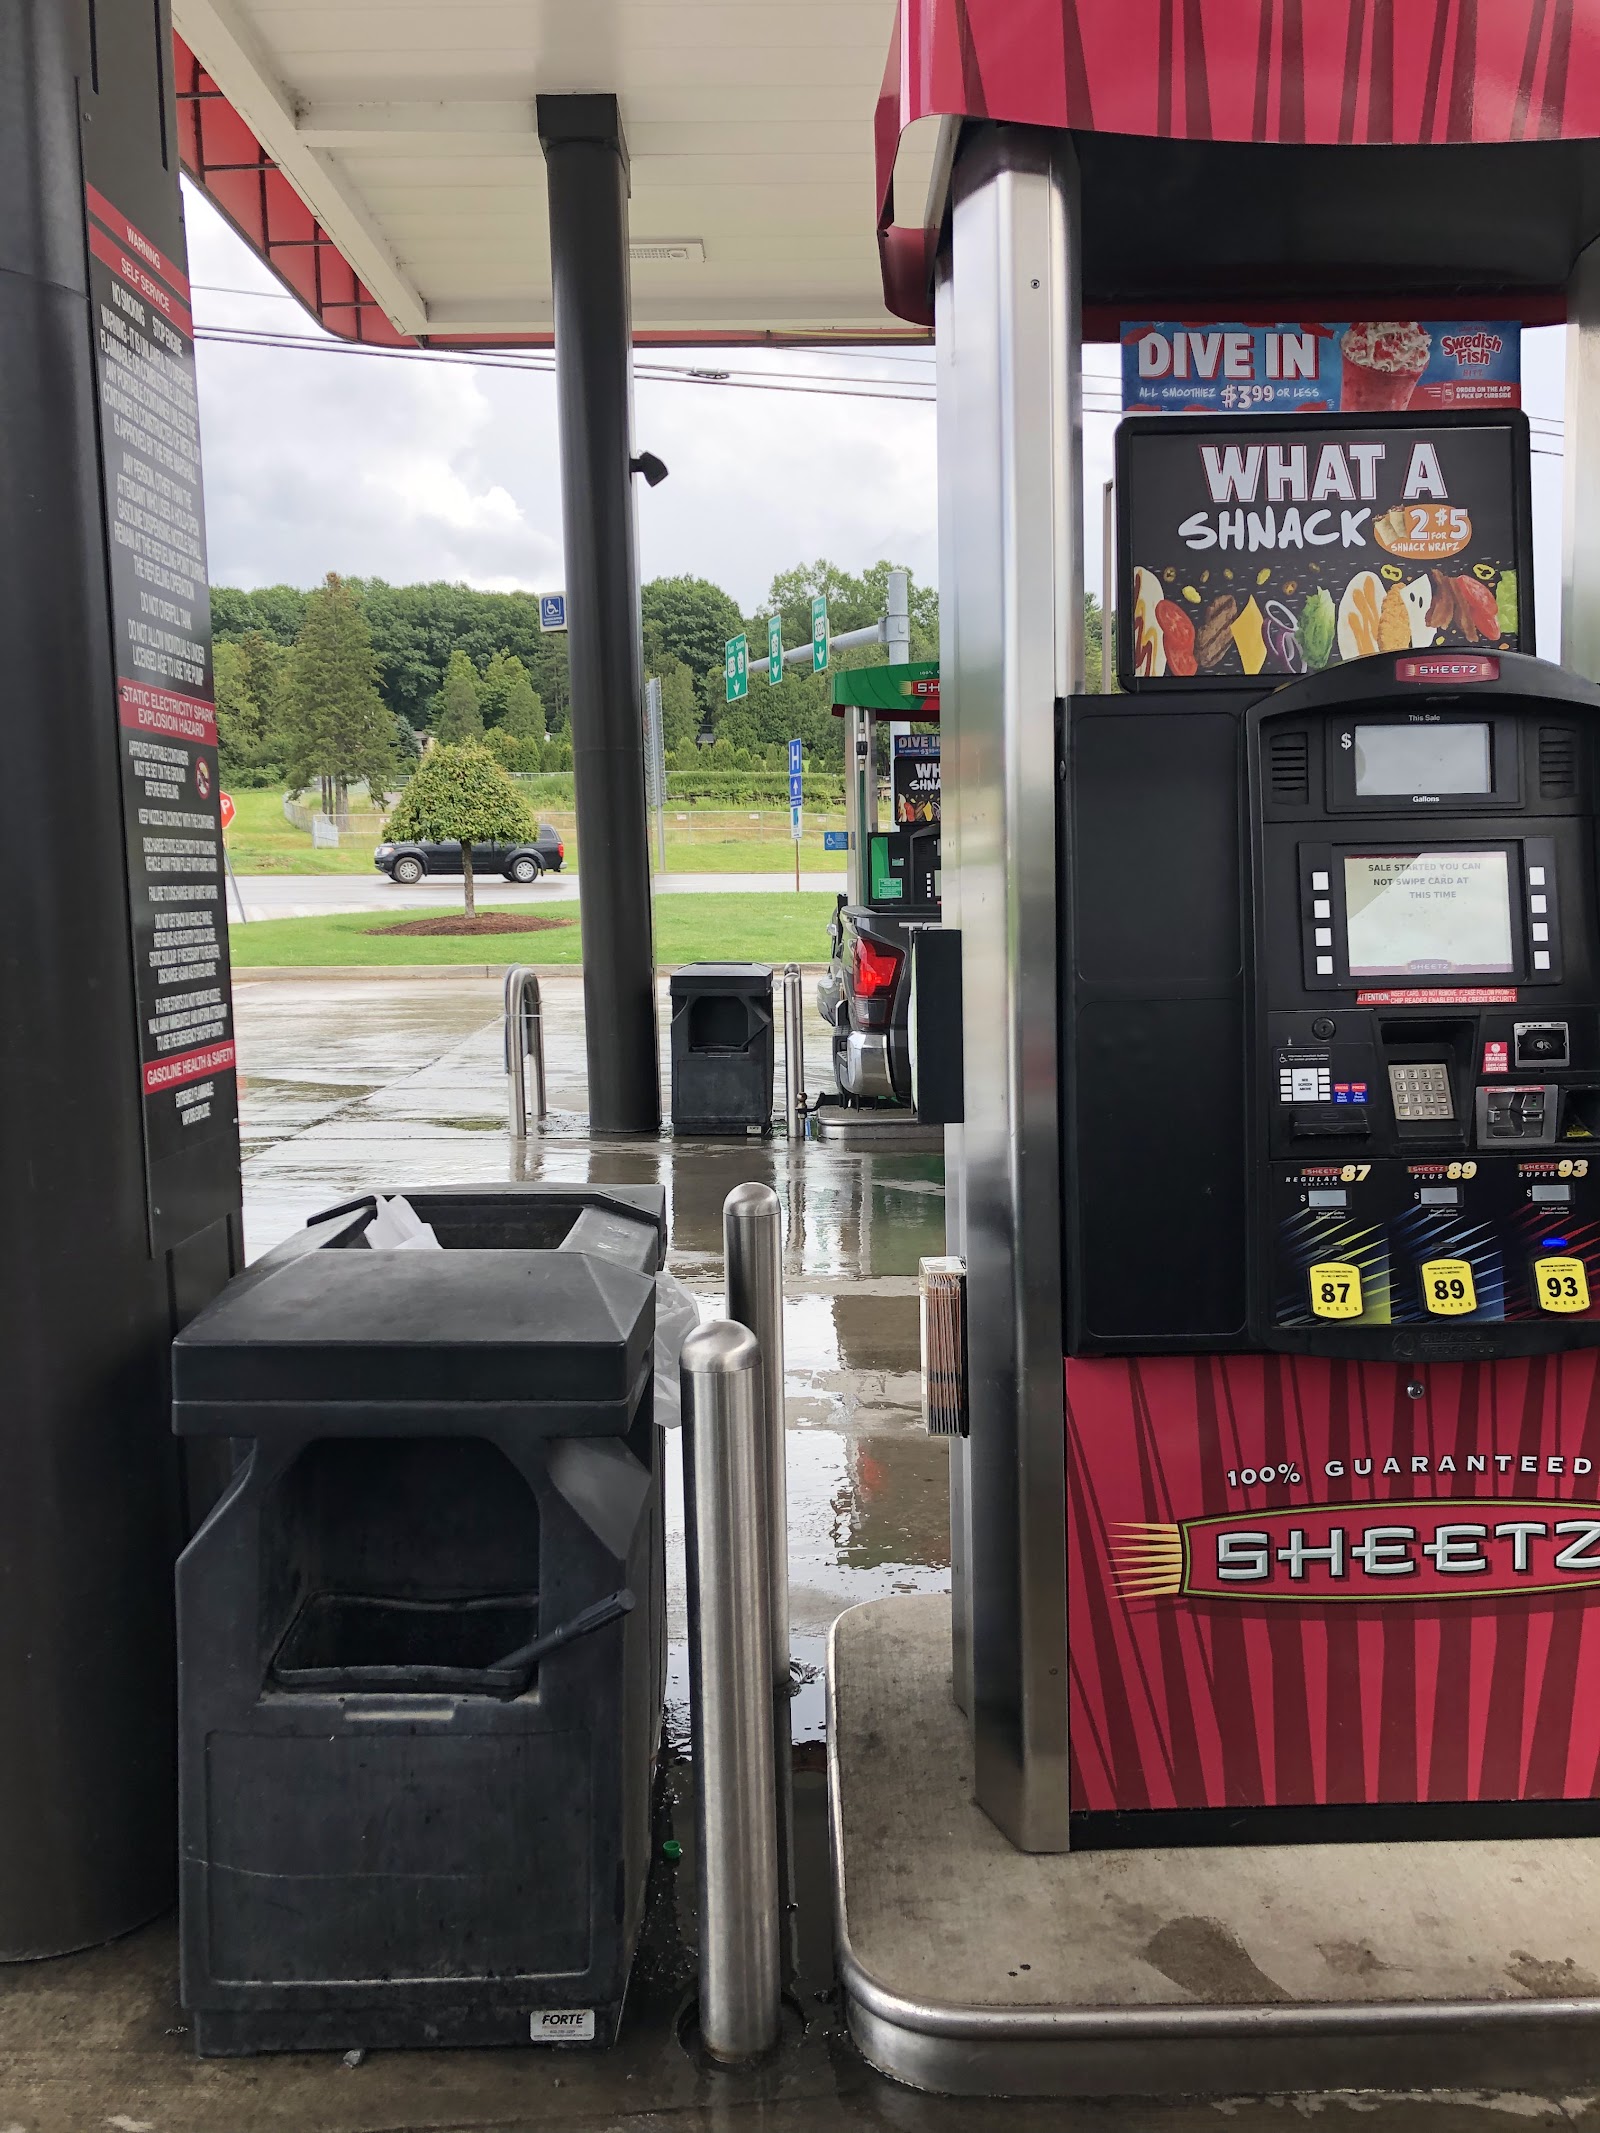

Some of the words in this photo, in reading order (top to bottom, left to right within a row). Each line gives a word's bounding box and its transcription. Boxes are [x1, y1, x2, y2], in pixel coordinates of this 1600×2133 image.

[126, 225, 160, 269] WARNING
[111, 279, 120, 307] NO
[121, 257, 141, 284] SELF
[140, 272, 170, 313] SERVICE
[1441, 332, 1502, 356] Swedish
[1138, 332, 1255, 380] DIVE
[1265, 333, 1319, 380] IN
[1456, 348, 1490, 365] Fish
[1139, 387, 1158, 397] ALL
[1162, 387, 1216, 397] SMOOTHIEZ
[1277, 388, 1290, 398] OR
[1293, 387, 1320, 397] LESS
[1199, 442, 1386, 502] WHAT
[1402, 441, 1449, 499] A
[1178, 505, 1371, 552] SHNACK
[1409, 508, 1429, 540] 2
[1431, 532, 1447, 540] FOR
[1390, 542, 1425, 552] SHNACK
[1428, 541, 1459, 552] WRAPZ
[1420, 665, 1478, 674] SHEETZ
[123, 686, 150, 706] STATIC
[150, 693, 193, 719] ELECTRICITY
[193, 704, 214, 724] SPARK
[138, 708, 178, 731] EXPLOSION
[178, 718, 205, 738] HAZARD
[899, 737, 929, 748] DIVE
[1341, 732, 1352, 750] $
[791, 745, 799, 770] H
[1396, 878, 1425, 886] SWIPE
[1428, 877, 1453, 885] CARD
[1410, 891, 1431, 899] THIS
[147, 1060, 182, 1085] GASOLINE
[182, 1055, 206, 1074] HEALTH
[211, 1047, 233, 1066] SAFETY
[1340, 1165, 1371, 1182] 87
[1447, 1161, 1477, 1179] 89
[1558, 1159, 1588, 1178] 93
[1414, 1192, 1419, 1200] $
[1526, 1189, 1532, 1197] $
[1321, 1283, 1350, 1303] 87
[1434, 1279, 1465, 1300] 89
[1547, 1277, 1578, 1298] 93
[1227, 1463, 1301, 1487] 100%
[1325, 1455, 1592, 1477] GUARANTEED
[1216, 1519, 1600, 1580] SHEETZ
